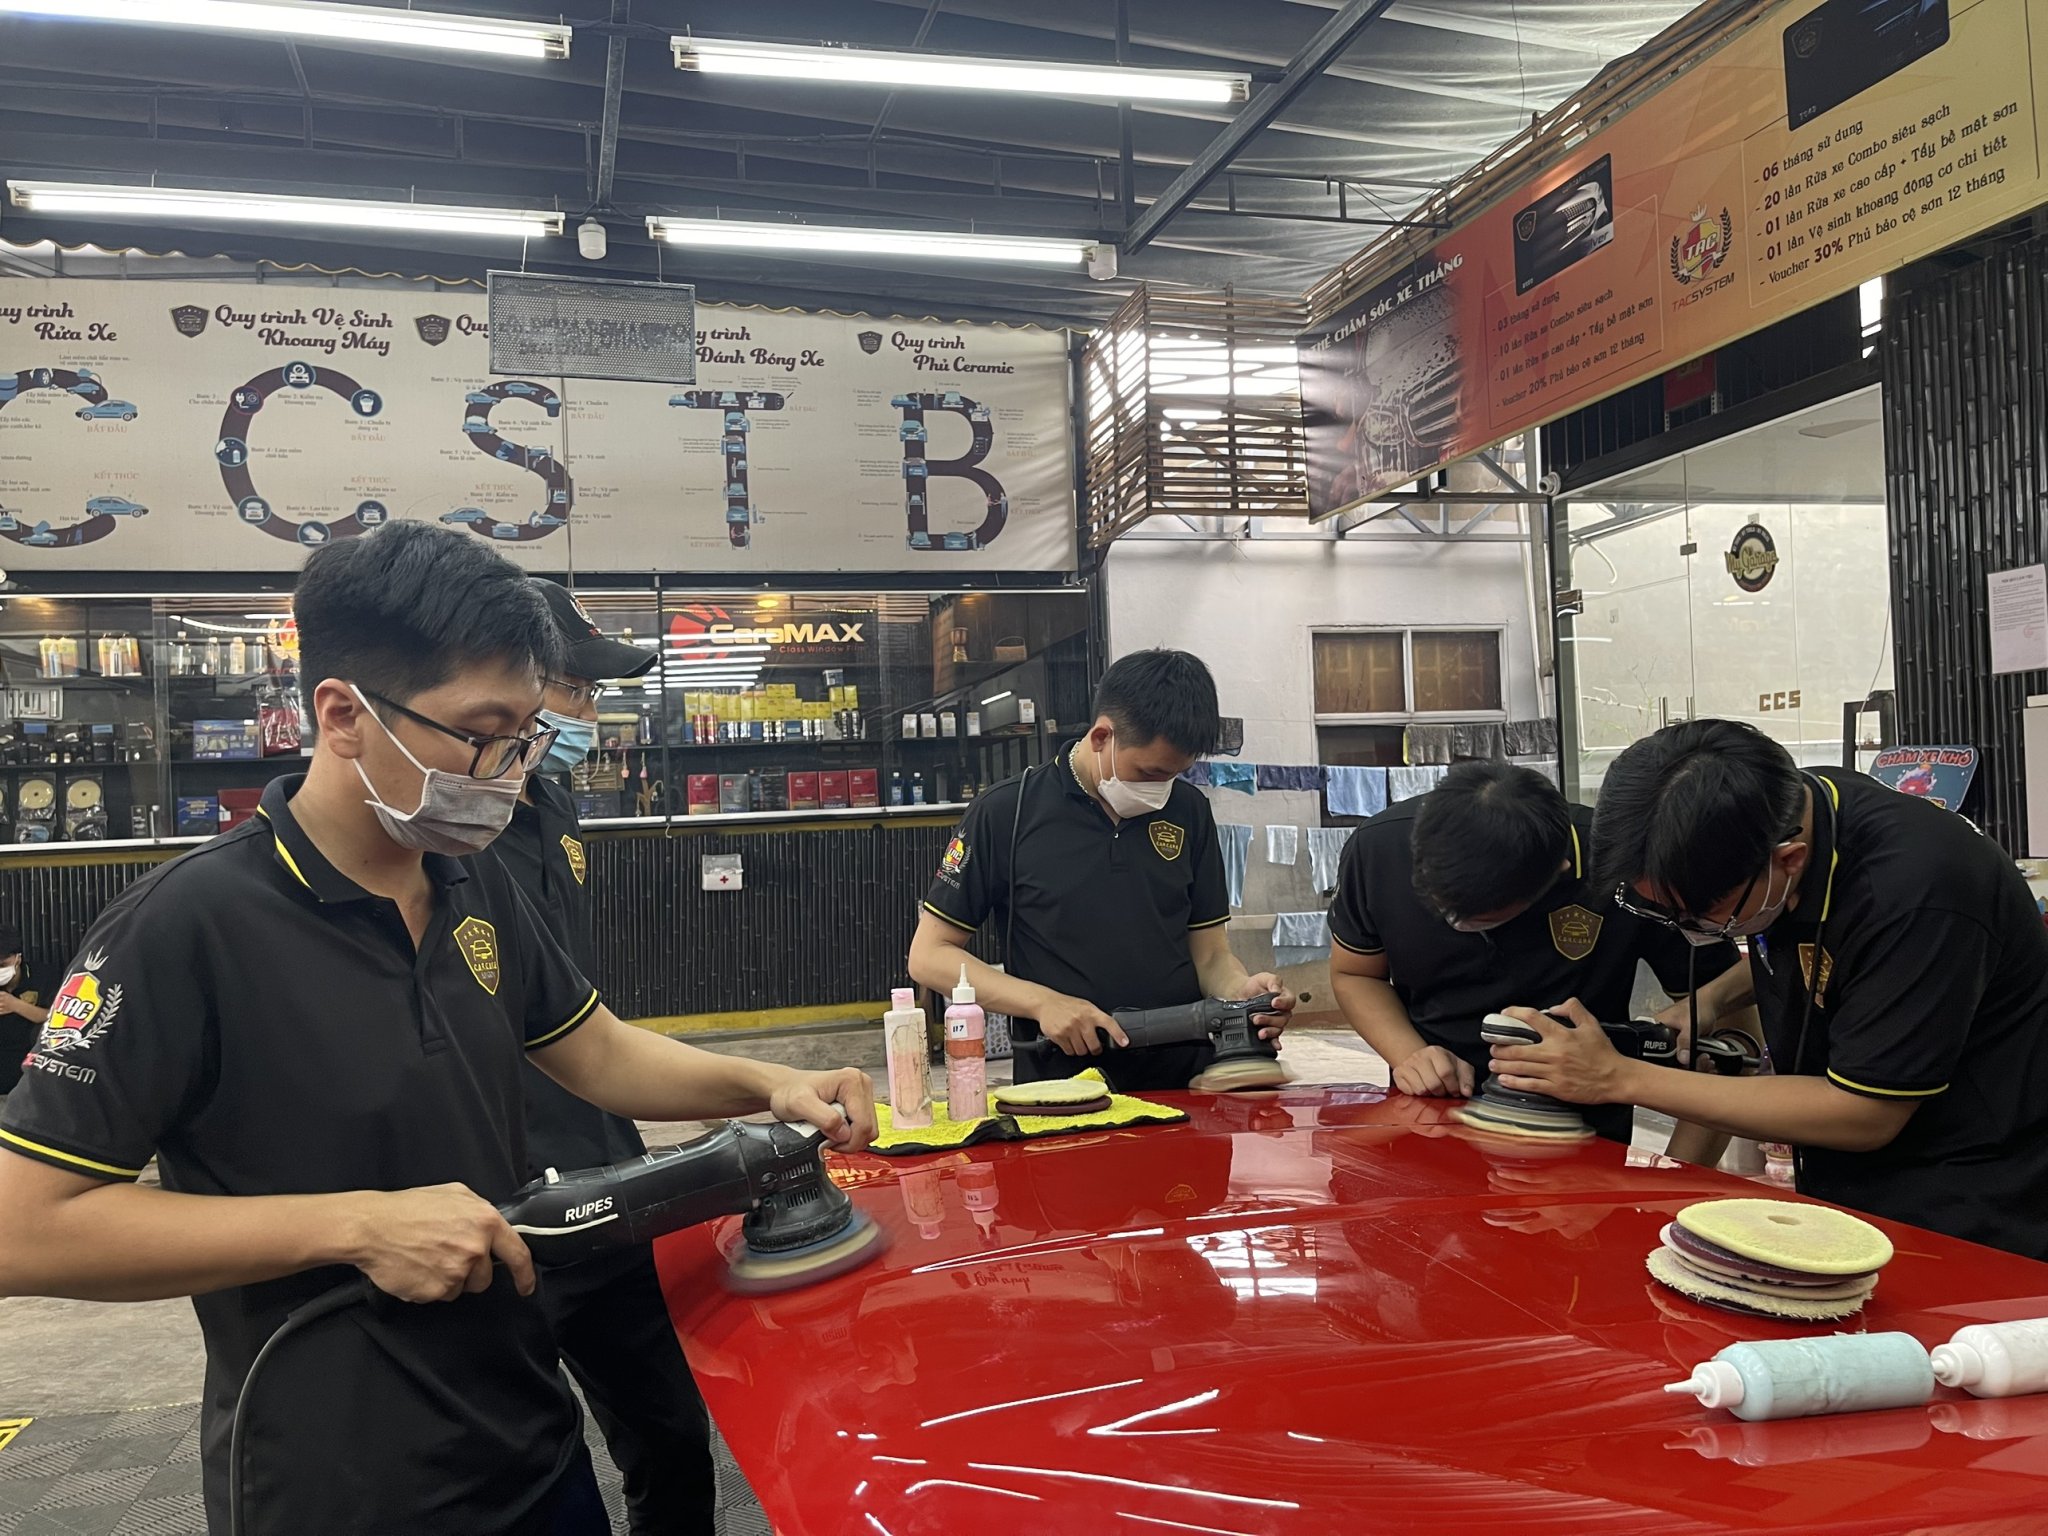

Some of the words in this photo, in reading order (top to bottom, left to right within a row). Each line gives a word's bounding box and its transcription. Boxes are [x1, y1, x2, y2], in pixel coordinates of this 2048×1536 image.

[1763, 162, 1779, 181] 06
[1783, 148, 1813, 171] tháng
[1817, 136, 1831, 152] sử
[1834, 121, 1863, 142] dụng
[1764, 191, 1780, 211] 20
[1785, 184, 1801, 200] lần
[1805, 170, 1827, 189] Rửa
[1832, 161, 1844, 176] xe
[1848, 139, 1887, 166] Combo
[1892, 124, 1916, 144] siêu
[1921, 104, 1950, 129] sạch
[1765, 216, 1780, 235] 01
[1786, 210, 1803, 226] lần
[1807, 198, 1829, 216] Rửa
[1833, 188, 1846, 202] xe
[1850, 176, 1870, 193] cao
[1874, 162, 1896, 181] cấp
[1993, 102, 2018, 122] sơn
[1767, 242, 1781, 260] 01
[1788, 235, 1805, 251] lần
[1808, 225, 1824, 240] Vệ
[1827, 212, 1852, 232] sinh
[1856, 190, 1899, 218] khoang
[1903, 173, 1934, 195] động
[1938, 162, 1953, 178] cơ
[1957, 149, 1978, 169] chi
[1982, 135, 2008, 157] tiết
[1769, 258, 1810, 283] Voucher
[1814, 238, 1844, 263] 30%
[1848, 227, 1871, 248] Phủ
[1876, 218, 1897, 236] bảo
[1902, 208, 1916, 223] vệ
[1921, 196, 1943, 215] sơn
[1947, 185, 1961, 202] 12
[1966, 168, 2005, 193] tháng
[1685, 232, 1719, 261] TAC
[1334, 314, 1367, 343] CHĂM
[1370, 297, 1393, 321] SÓC
[1396, 285, 1413, 305] XE
[1416, 253, 1463, 292] THÁNG
[1671, 272, 1735, 312] TACSYSTEM
[0, 305, 21, 324] uy
[27, 302, 74, 318] trình
[215, 304, 256, 329] Quy
[260, 309, 307, 325] trình
[312, 308, 345, 331] Vệ
[349, 310, 393, 328] Sinh
[1550, 311, 1574, 329] Combo
[34, 322, 82, 341] Rửa
[87, 323, 117, 341] Xe
[258, 328, 336, 355] Khoang
[341, 331, 391, 357] Máy
[711, 326, 751, 341] trình
[891, 331, 924, 353] Quy
[928, 336, 965, 350] trình
[696, 346, 746, 364] Đánh
[750, 348, 796, 372] Bóng
[800, 350, 825, 367] Xe
[913, 355, 950, 372] Phủ
[953, 356, 1015, 374] Ceramic
[1529, 377, 1547, 395] 20%
[710, 623, 864, 644] CeraMAX
[1759, 690, 1800, 712] CCS
[56, 995, 95, 1020] TAC
[1643, 1040, 1668, 1050] RUPES
[564, 1196, 613, 1222] RUPES
